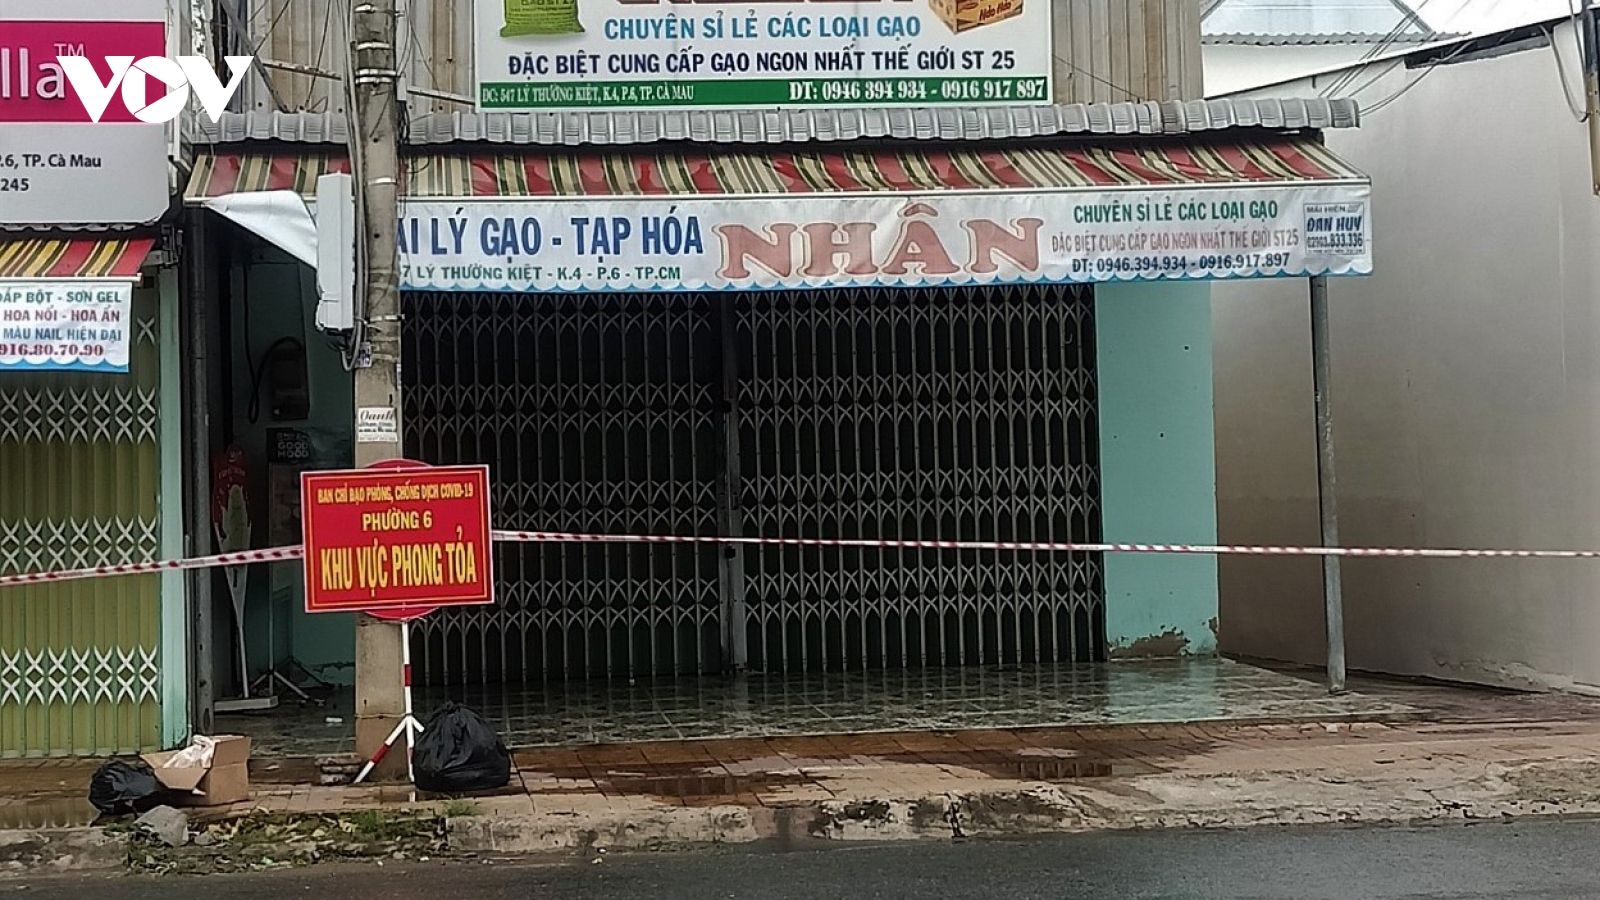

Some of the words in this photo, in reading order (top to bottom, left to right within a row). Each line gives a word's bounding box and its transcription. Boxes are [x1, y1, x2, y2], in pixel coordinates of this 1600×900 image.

[604, 13, 695, 40] CHUYÊN
[702, 10, 724, 39] SỈ
[732, 9, 758, 38] LẺ
[767, 11, 812, 38] CÁC
[819, 16, 869, 42] LOẠI
[877, 15, 921, 42] GẠO
[508, 51, 549, 80] ĐẶC
[555, 50, 600, 78] BIỆT
[608, 53, 660, 74] CUNG
[665, 45, 704, 74] CẤP
[710, 51, 750, 76] GẠO
[756, 51, 808, 72] NGON
[815, 44, 865, 71] NHẤT
[872, 43, 912, 70] THẾ
[917, 45, 955, 70] GIỚI
[961, 50, 984, 70] ST
[991, 50, 1015, 70] 25
[500, 88, 515, 102] 547
[518, 83, 531, 102] LÝ
[532, 82, 574, 102] THƯỜNG
[575, 82, 601, 104] KIỆT,
[639, 85, 656, 100] TP.
[656, 81, 670, 100] CÀ
[672, 85, 694, 100] MAU
[822, 81, 861, 100] 0946
[865, 80, 893, 100] 394
[898, 80, 926, 99] 934
[941, 79, 980, 99] 0916
[983, 79, 1011, 98] 917
[1016, 78, 1045, 97] 897
[0, 154, 19, 170] .6,
[22, 154, 45, 168] TP.
[48, 151, 66, 168] Cà
[70, 155, 101, 168] Mau
[1074, 199, 1132, 223] CHUYÊN
[1136, 196, 1150, 221] SỈ
[1155, 195, 1173, 221] LẺ
[1178, 197, 1206, 221] CÁC
[1212, 201, 1245, 223] LOẠI
[1249, 200, 1278, 222] GẠO
[431, 207, 468, 255] LÝ
[480, 217, 542, 264] GẠO
[552, 237, 562, 246] -
[571, 216, 631, 264] TẠP
[642, 205, 703, 255] HÓA
[712, 202, 1044, 279] NHÂN
[1052, 231, 1072, 257] ĐẶC
[1074, 229, 1097, 256] BIỆT
[1099, 234, 1126, 252] CUNG
[1128, 226, 1148, 251] CẤP
[1150, 232, 1170, 254] GẠO
[1172, 231, 1198, 250] NGON
[1200, 225, 1225, 249] NHẤT
[1229, 224, 1248, 248] THẾ
[1251, 225, 1271, 248] GIỚI
[1274, 228, 1299, 247] ST25
[417, 263, 435, 279] LÝ
[441, 262, 503, 280] THƯỜNG
[508, 264, 542, 282] KIỆT
[557, 266, 581, 280] K.4
[597, 266, 621, 280] P.6
[634, 266, 681, 280] TP.CM
[1072, 258, 1094, 273] ĐT:
[1097, 255, 1186, 272] 0946.394.934
[1200, 253, 1291, 270] 0916.917.897
[97, 291, 122, 303] GEL
[3, 309, 30, 321] HOA
[71, 309, 97, 322] HOA
[35, 327, 63, 340] NAIL
[318, 487, 334, 504] BAN
[335, 482, 348, 503] CHỈ
[395, 479, 420, 501] CHỐNG
[421, 483, 439, 502] DỊCH
[440, 482, 474, 499] COVID-19
[362, 507, 420, 531] PHƯỜNG
[423, 510, 432, 528] 6
[321, 547, 352, 591] KHU
[356, 538, 388, 597] VỰC
[392, 542, 443, 588] PHONG
[445, 525, 477, 584] TỎA
